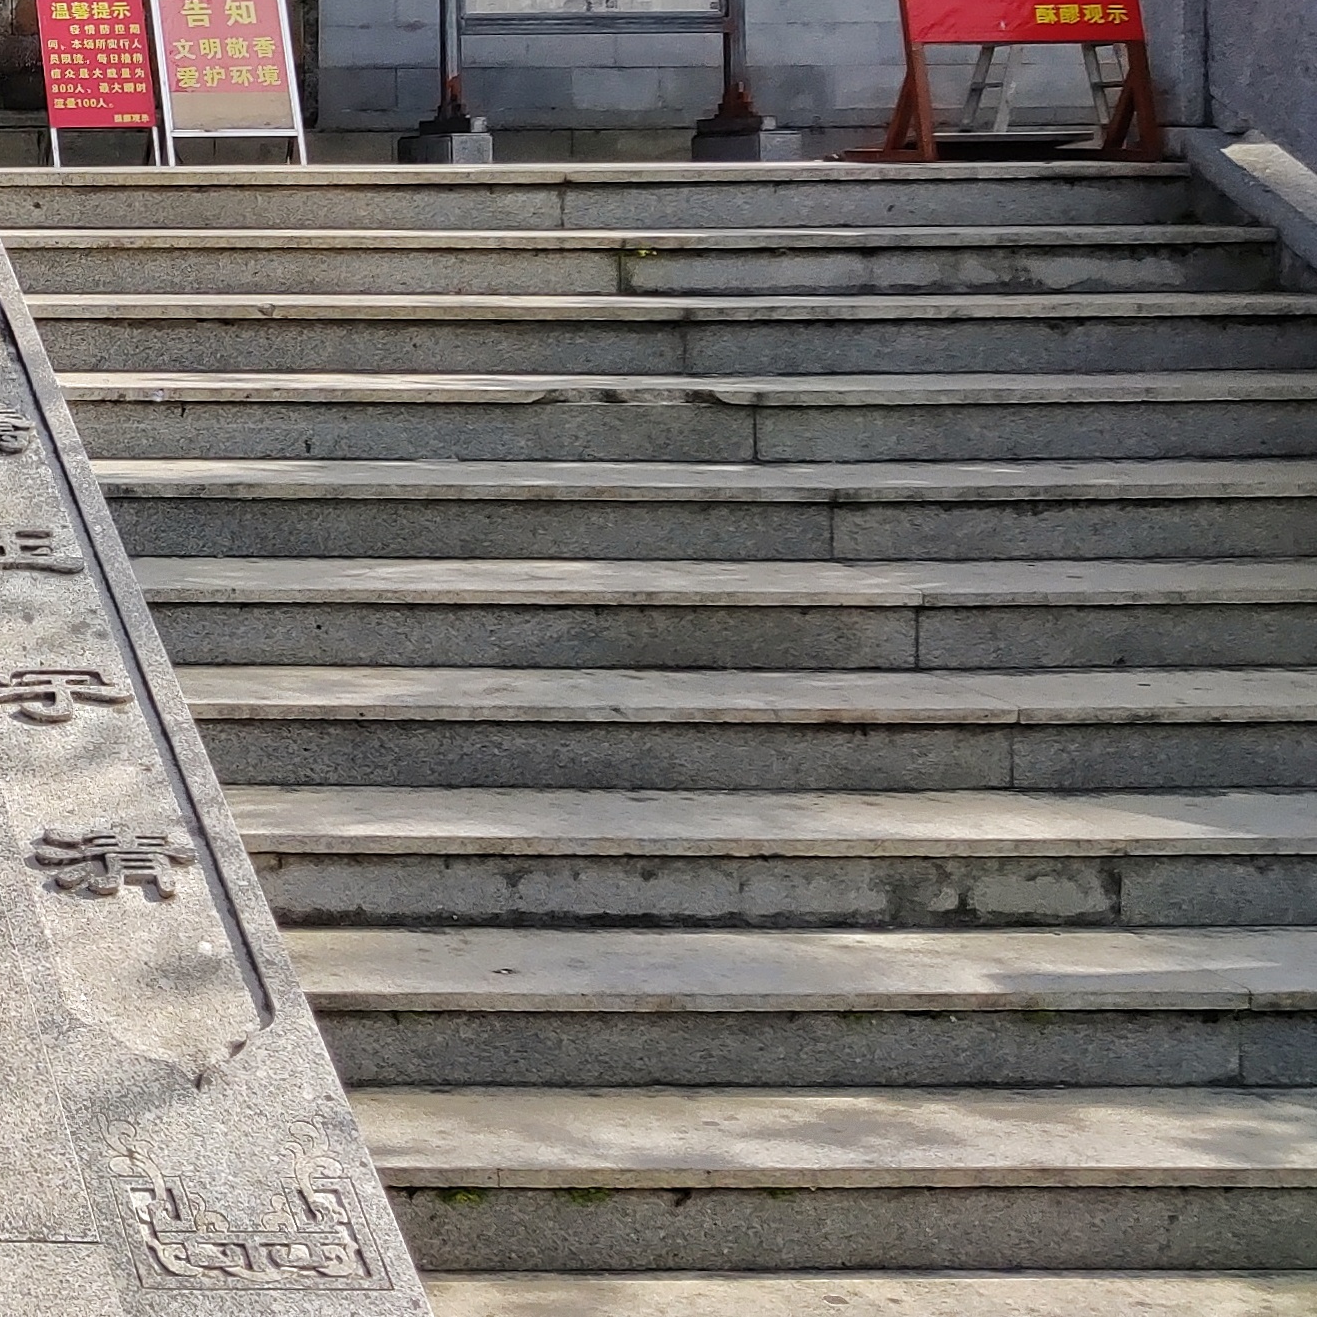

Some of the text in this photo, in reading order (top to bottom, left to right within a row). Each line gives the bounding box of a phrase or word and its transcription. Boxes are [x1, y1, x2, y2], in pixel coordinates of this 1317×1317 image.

[50, 2, 132, 20] 温馨提示
[1034, 3, 1130, 25] 酥醪观示
[172, 36, 277, 61] 文明敬香
[176, 64, 282, 89] 爱护环境
